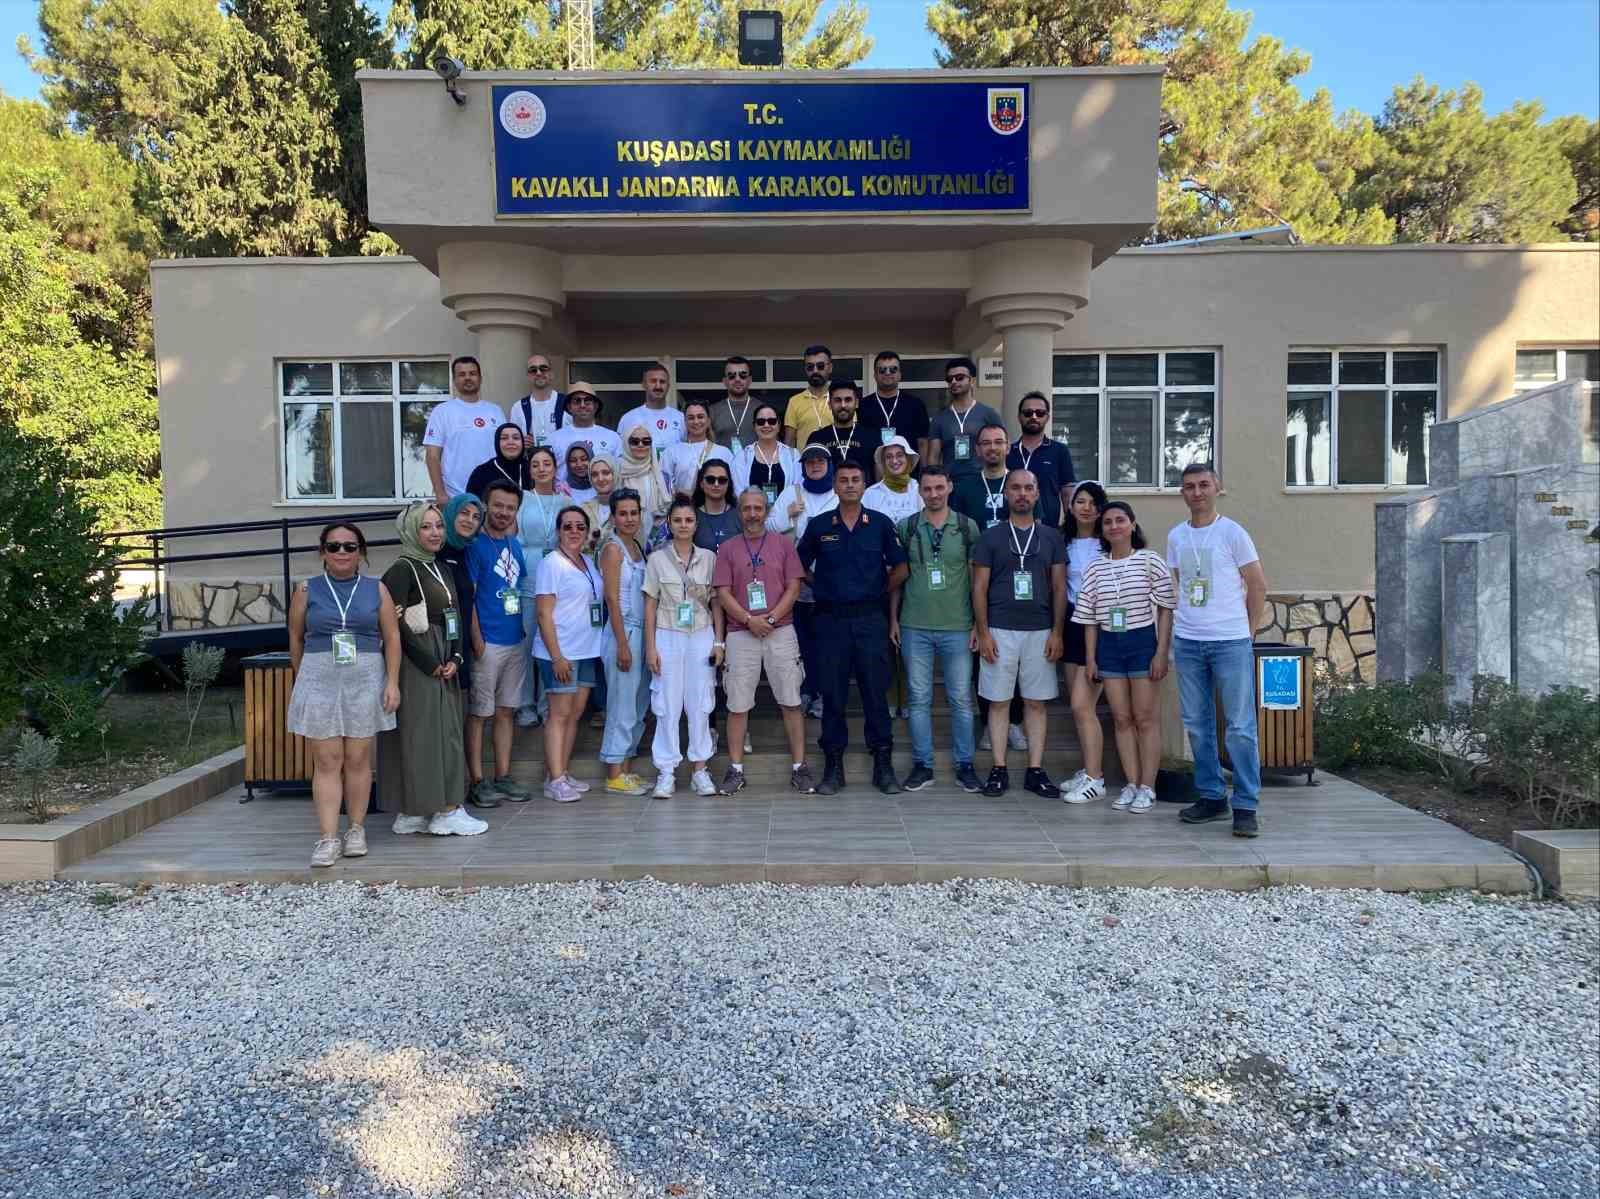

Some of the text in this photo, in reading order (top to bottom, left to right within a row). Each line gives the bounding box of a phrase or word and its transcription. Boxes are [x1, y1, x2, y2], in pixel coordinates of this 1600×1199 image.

[743, 103, 784, 125] T.C.
[616, 134, 911, 167] KUŞADASI KAYMAKAMLIĞI
[511, 169, 1015, 198] KAVAKLI JANDARMA KARAKOL KOMUTANLIĞI
